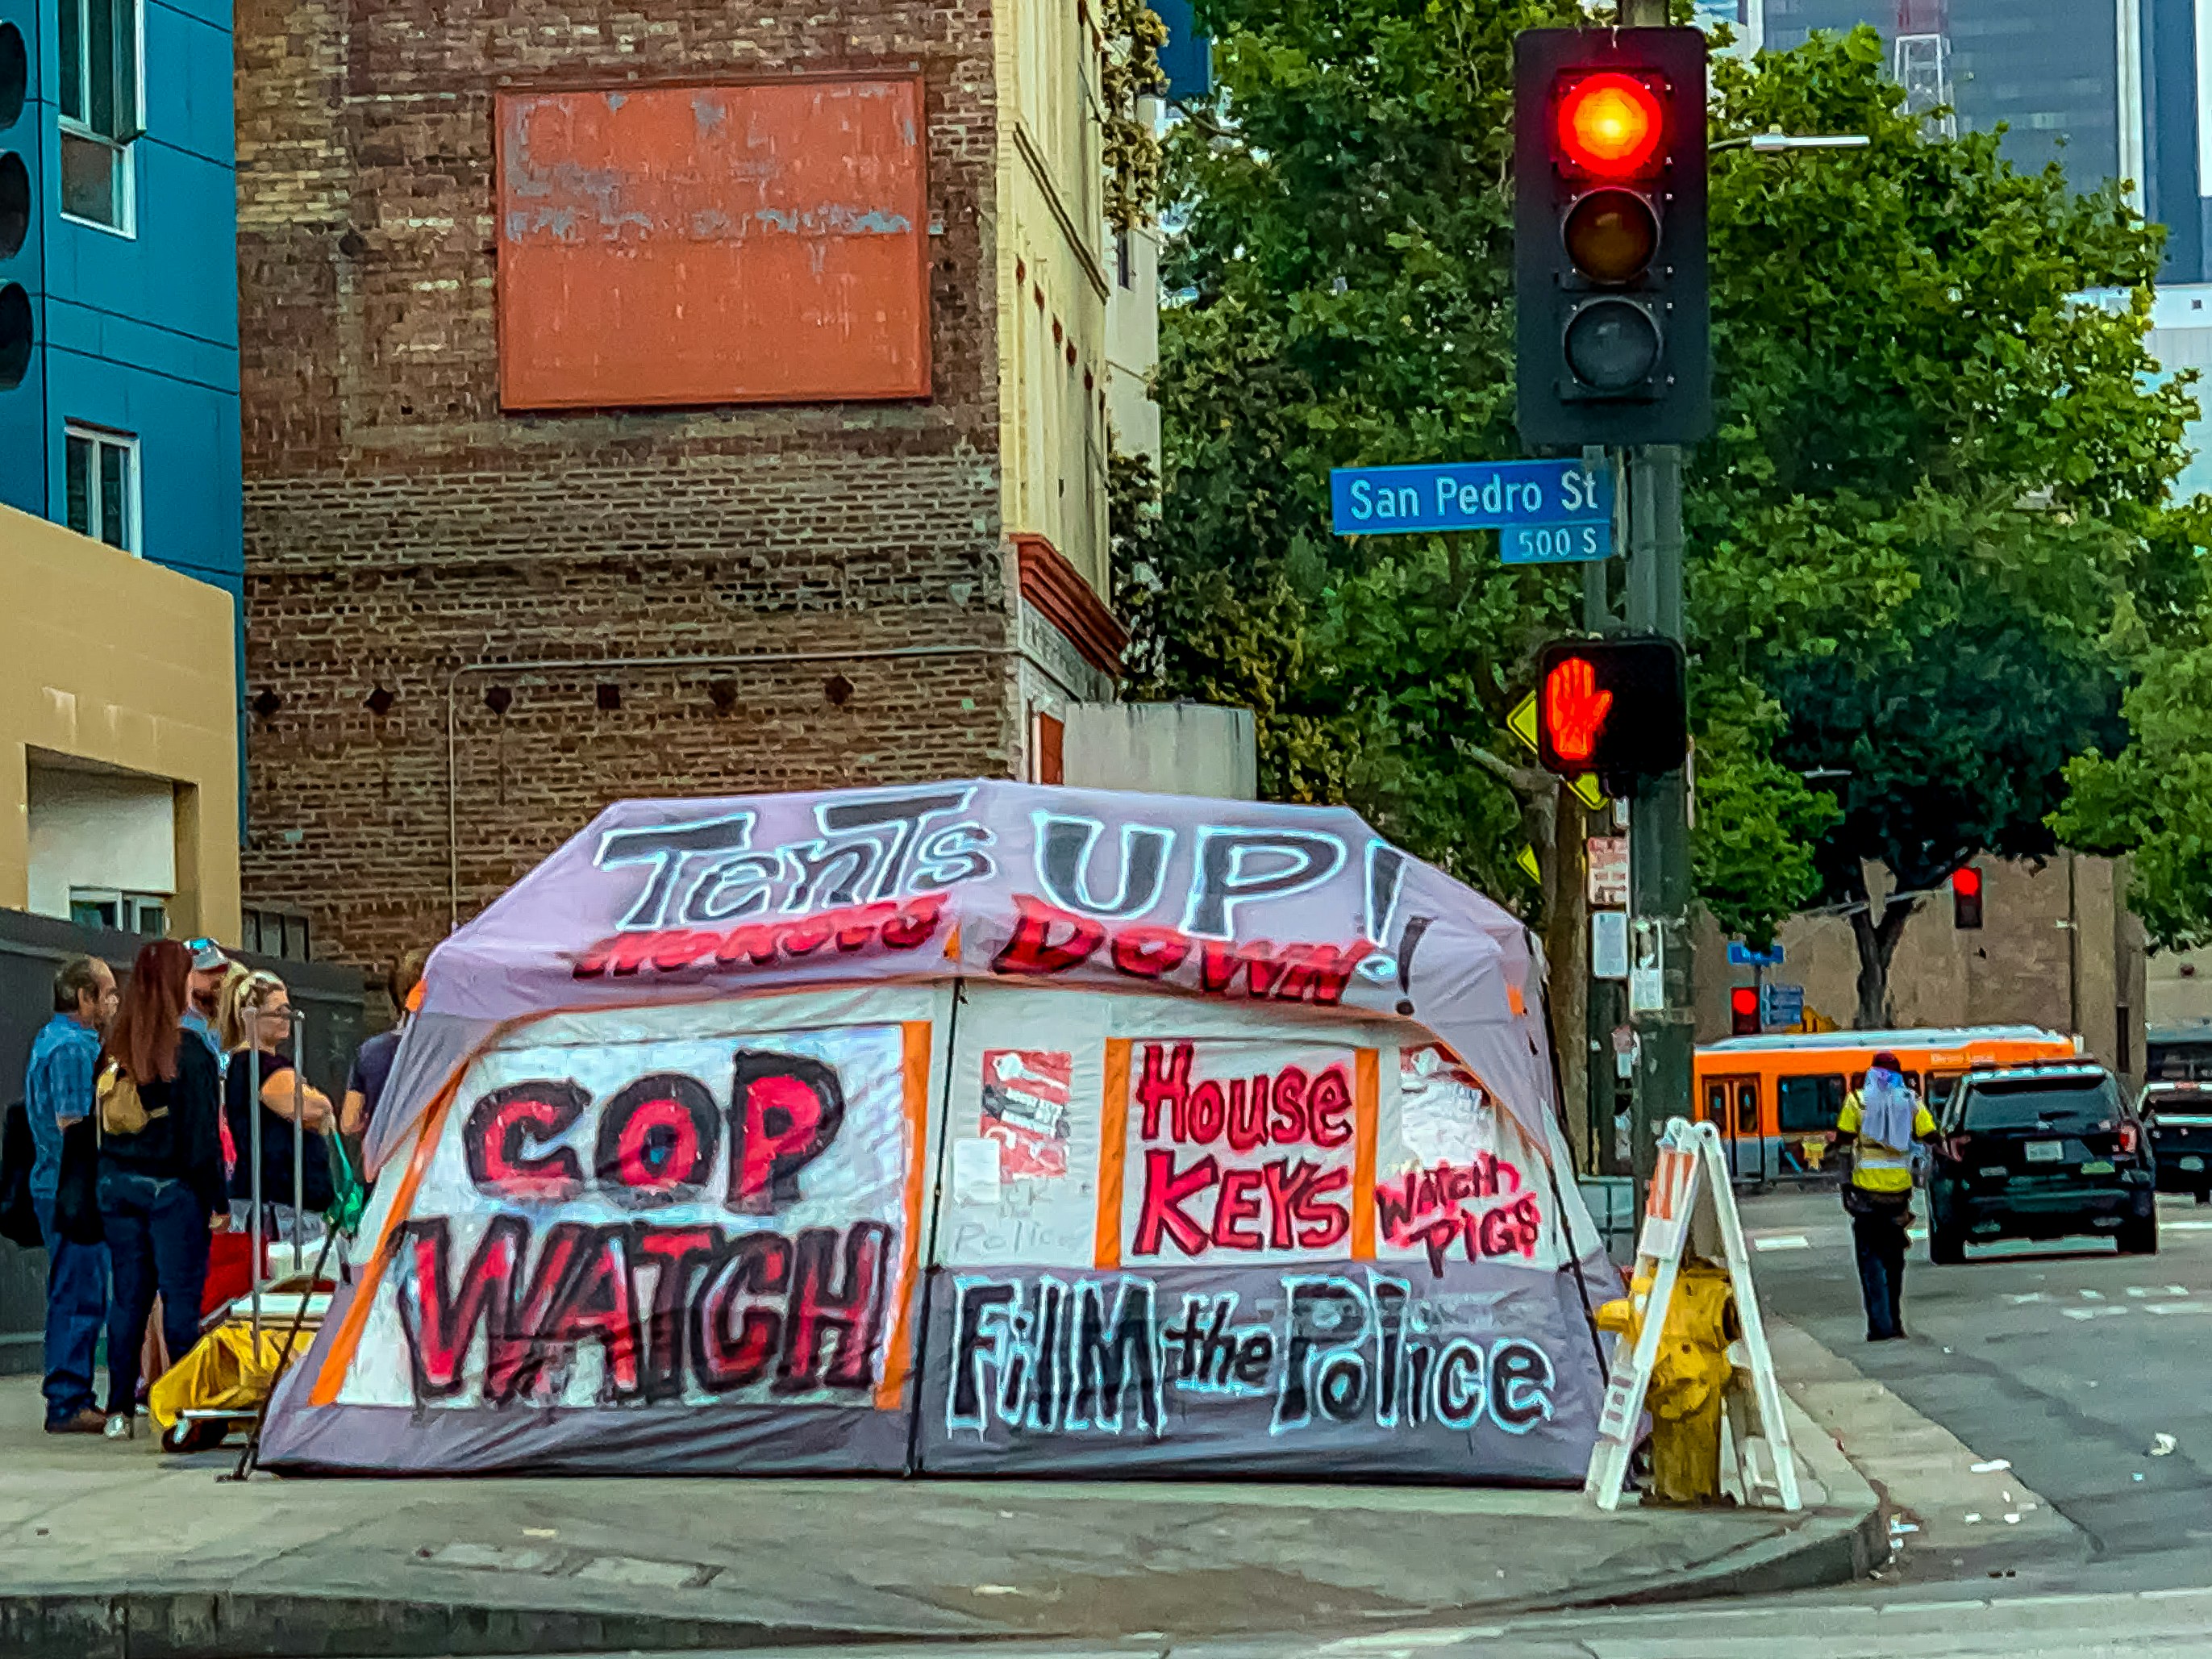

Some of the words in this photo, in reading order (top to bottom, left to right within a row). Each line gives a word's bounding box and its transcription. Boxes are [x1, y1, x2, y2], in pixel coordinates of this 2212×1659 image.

[1350, 479, 1420, 520] San
[1435, 473, 1542, 516] Pedro
[1561, 469, 1599, 511] St
[1519, 528, 1571, 557] 500
[1582, 527, 1597, 554] S
[464, 1048, 846, 1215] COP
[1132, 1148, 1352, 1257] KEYS
[395, 1214, 892, 1421] WATCH
[1270, 1267, 1556, 1437] Police
